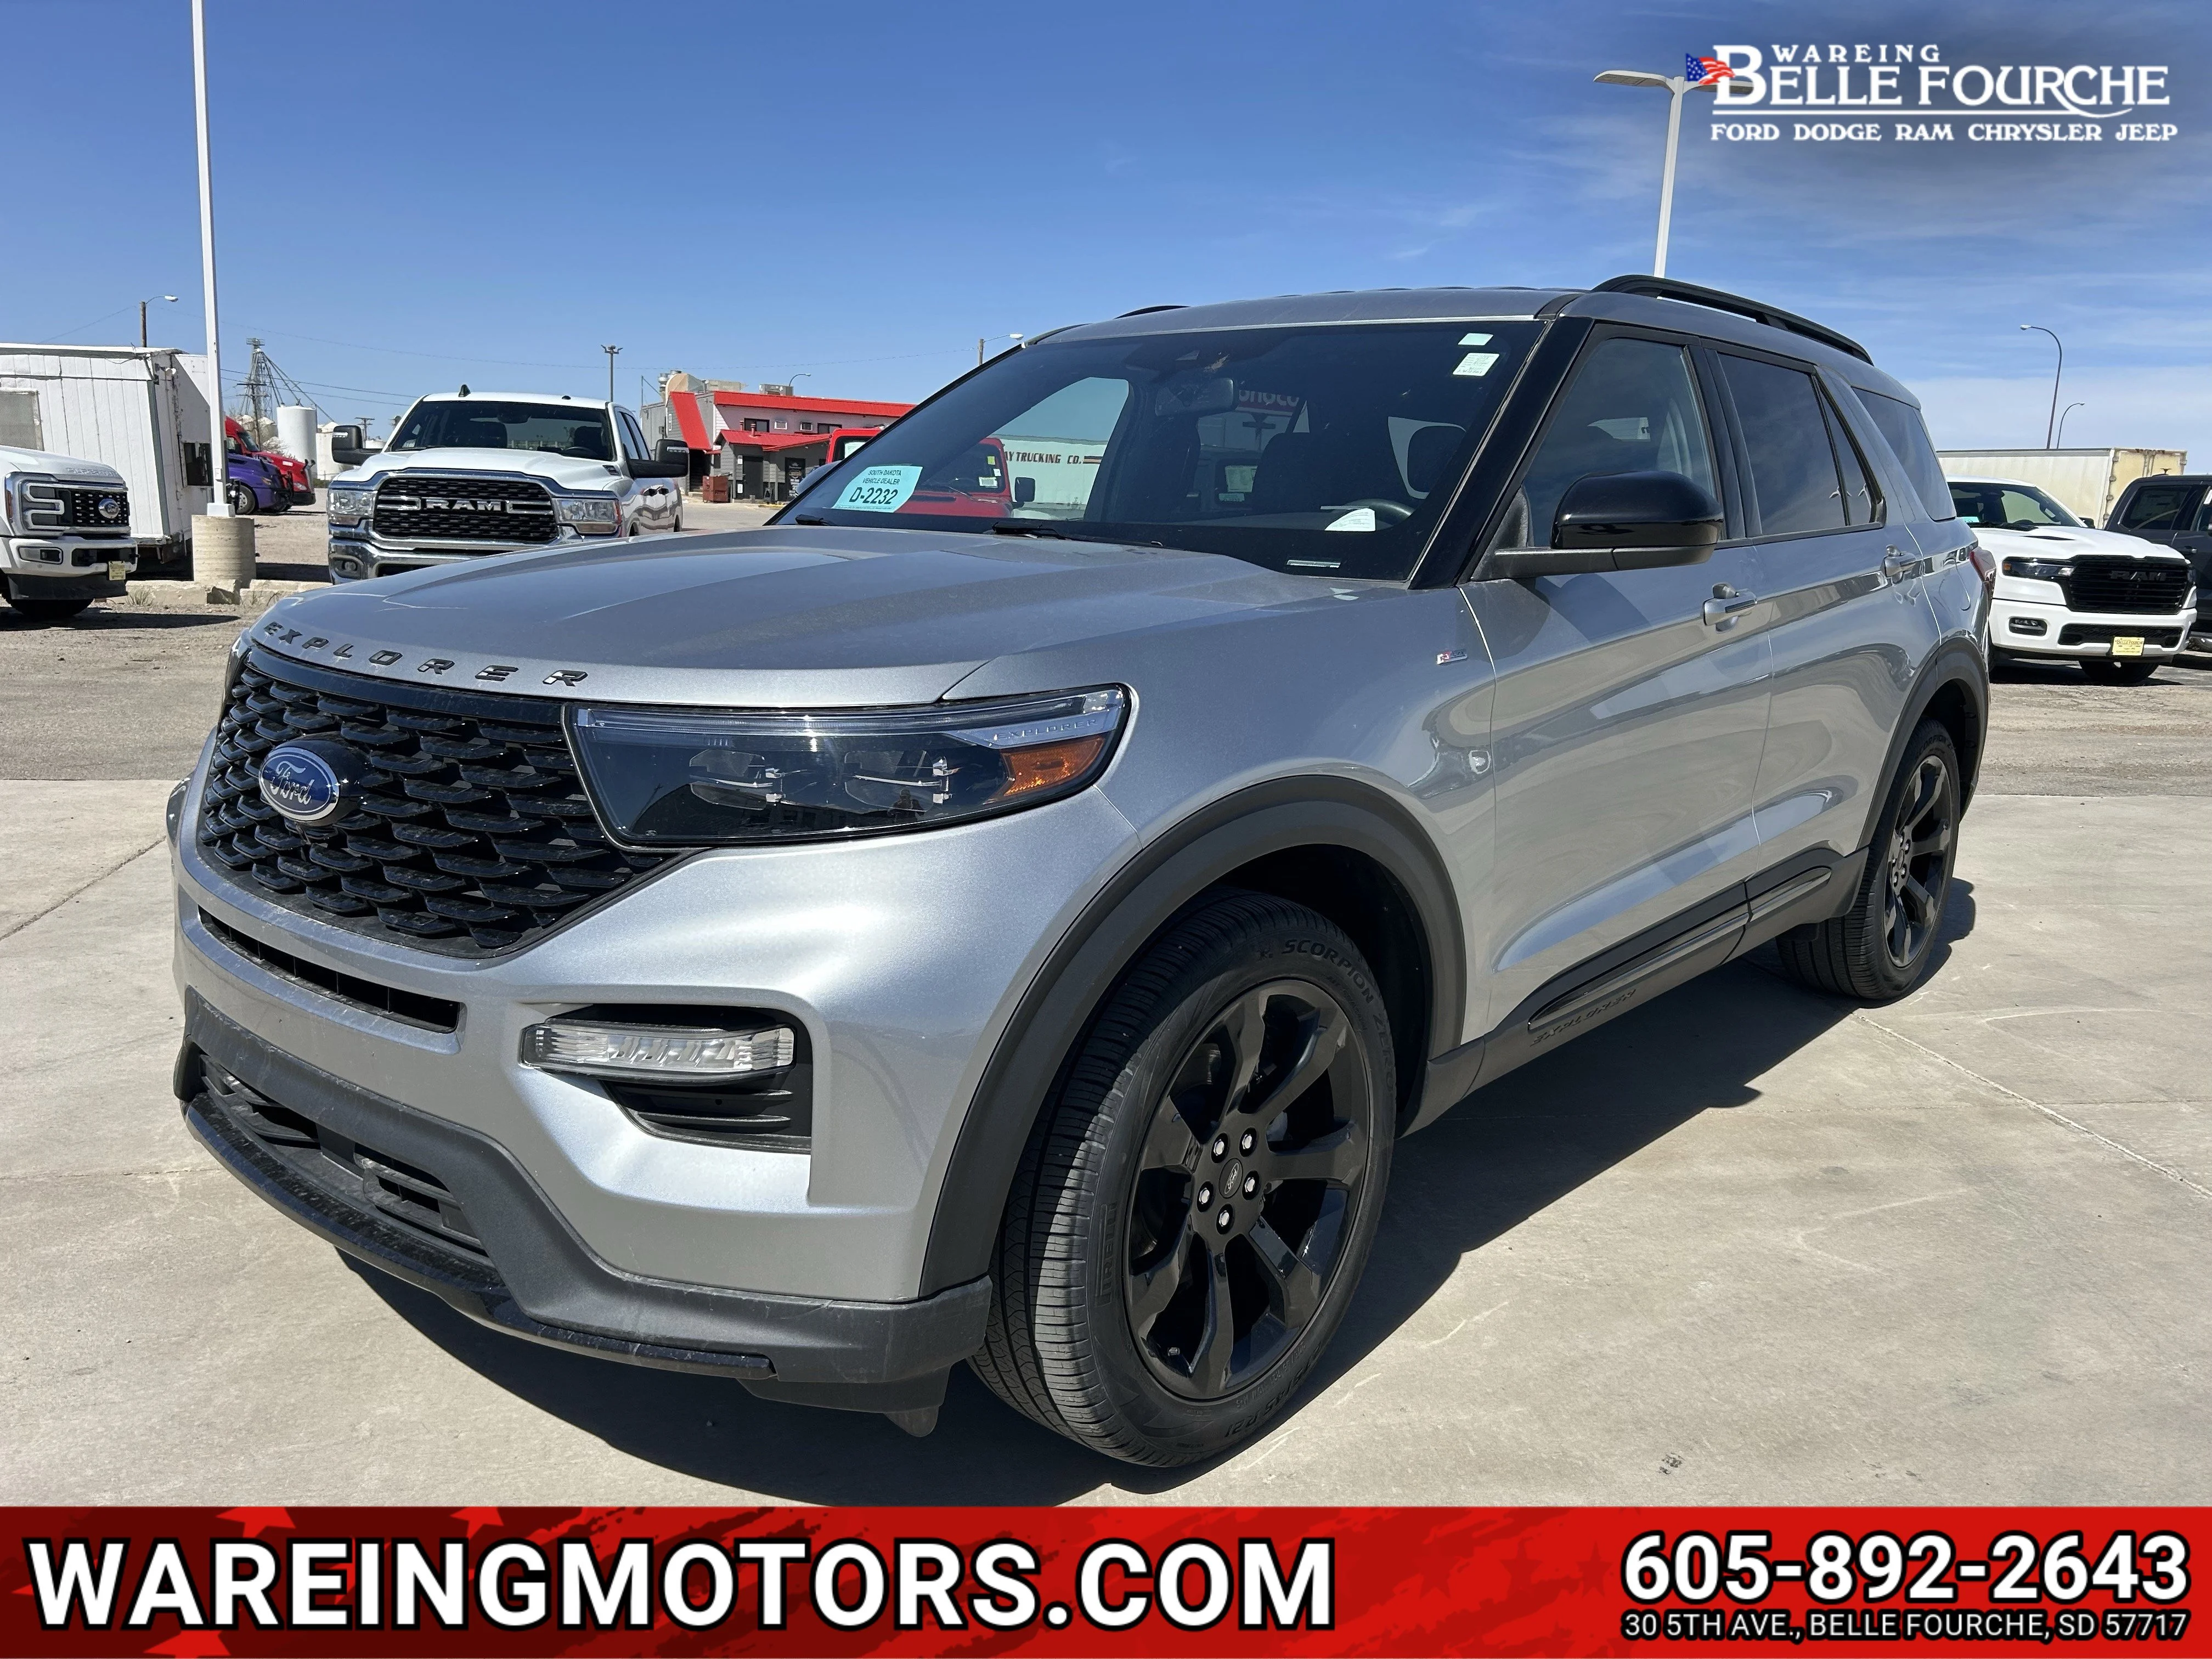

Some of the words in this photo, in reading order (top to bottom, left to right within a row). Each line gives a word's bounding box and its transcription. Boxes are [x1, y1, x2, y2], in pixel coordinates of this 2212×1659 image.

[1016, 452, 1062, 464] TRUCKING
[1066, 455, 1082, 465] CO.
[426, 498, 501, 511] RAM
[849, 487, 899, 505] D-2232
[2110, 570, 2166, 581] RAM
[263, 620, 589, 687] EXPLORER
[993, 719, 1098, 741] EXPLORER
[269, 760, 315, 805] Ford
[1281, 939, 1374, 1003] SCORPION
[1530, 989, 1637, 1047] EXPLORER
[1093, 1200, 1118, 1308] PIRELLI
[1224, 1409, 1261, 1438] R21
